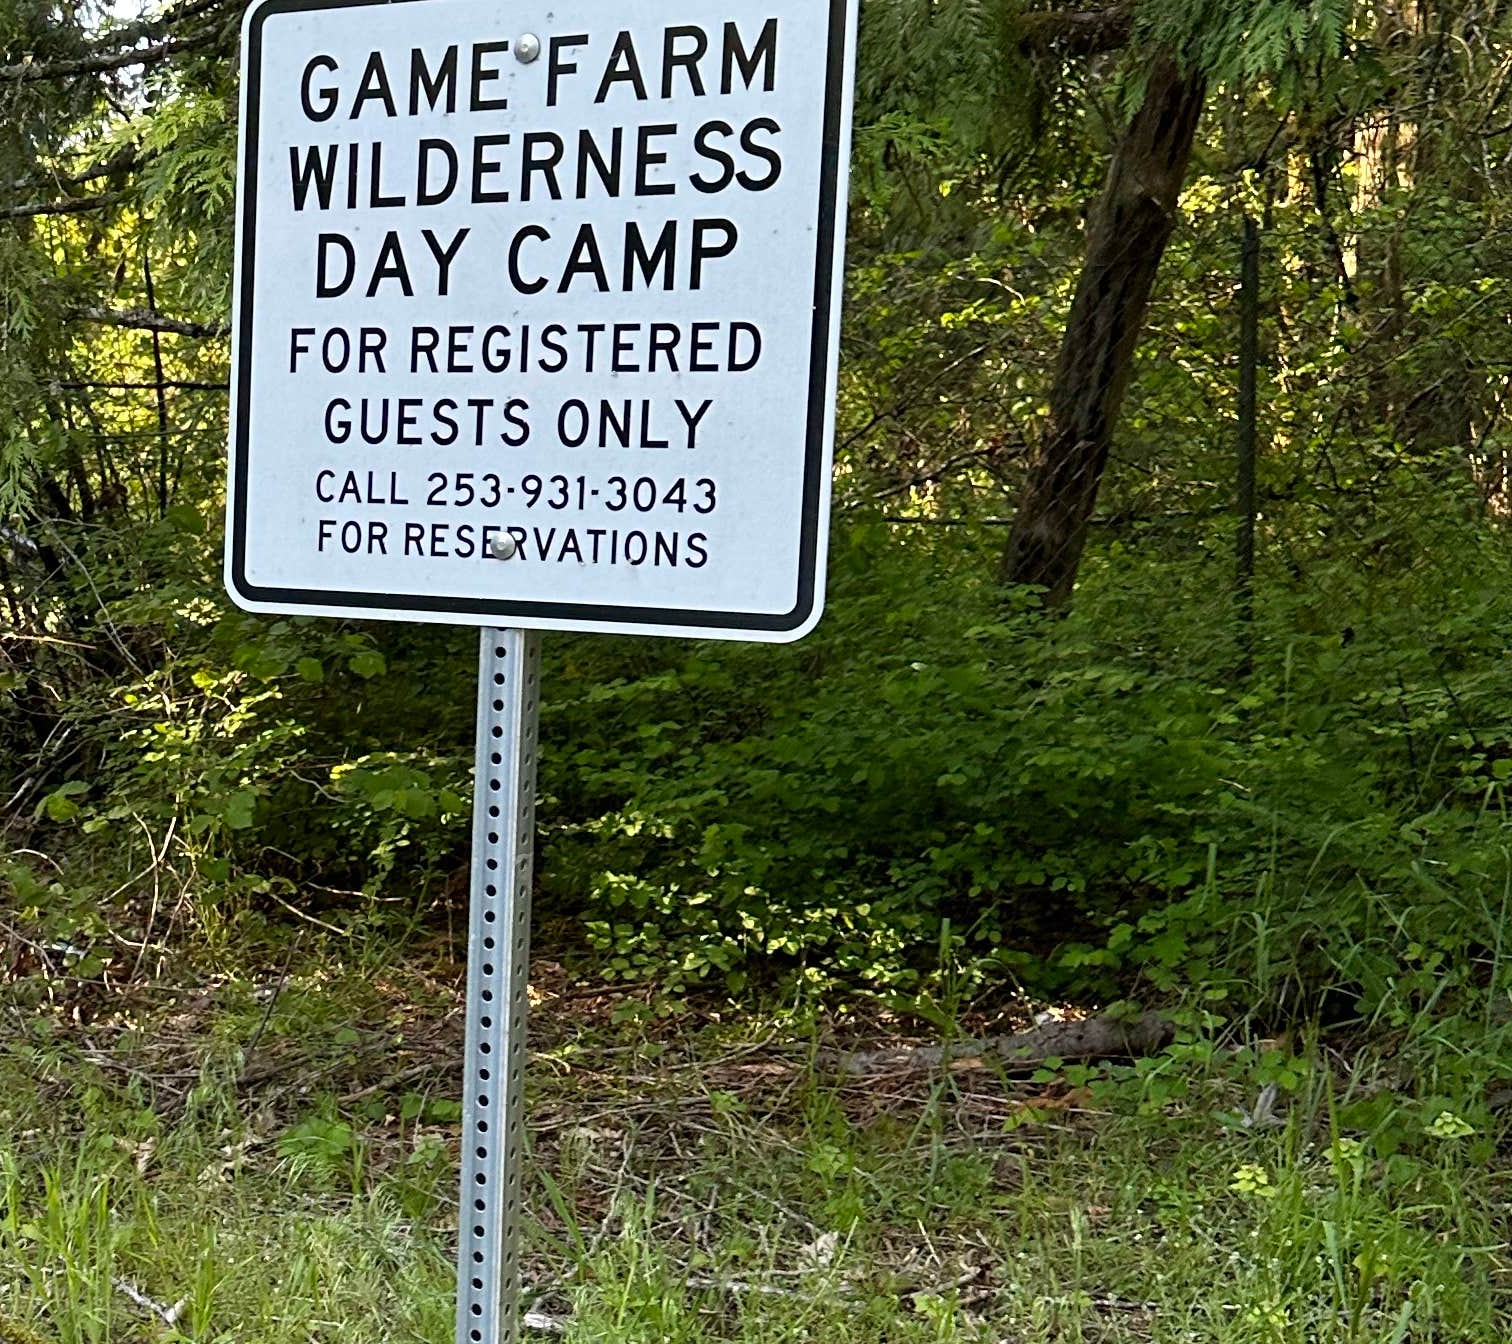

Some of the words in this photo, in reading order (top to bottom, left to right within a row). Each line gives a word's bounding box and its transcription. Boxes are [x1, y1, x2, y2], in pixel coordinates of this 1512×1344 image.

[301, 41, 508, 122] GAME
[547, 18, 777, 106] FARM
[290, 118, 781, 211] WILDERNESS
[316, 228, 470, 298] DAY
[508, 219, 737, 294] CAMP
[290, 327, 386, 373] FOR
[411, 322, 761, 373] REGISTERED
[325, 398, 529, 446] GUESTS
[558, 399, 713, 448] ONLY
[317, 470, 408, 504] CALL
[427, 473, 715, 513] 253-931-3043
[319, 520, 387, 554] FOR
[405, 523, 707, 568] RESERVATIONS
